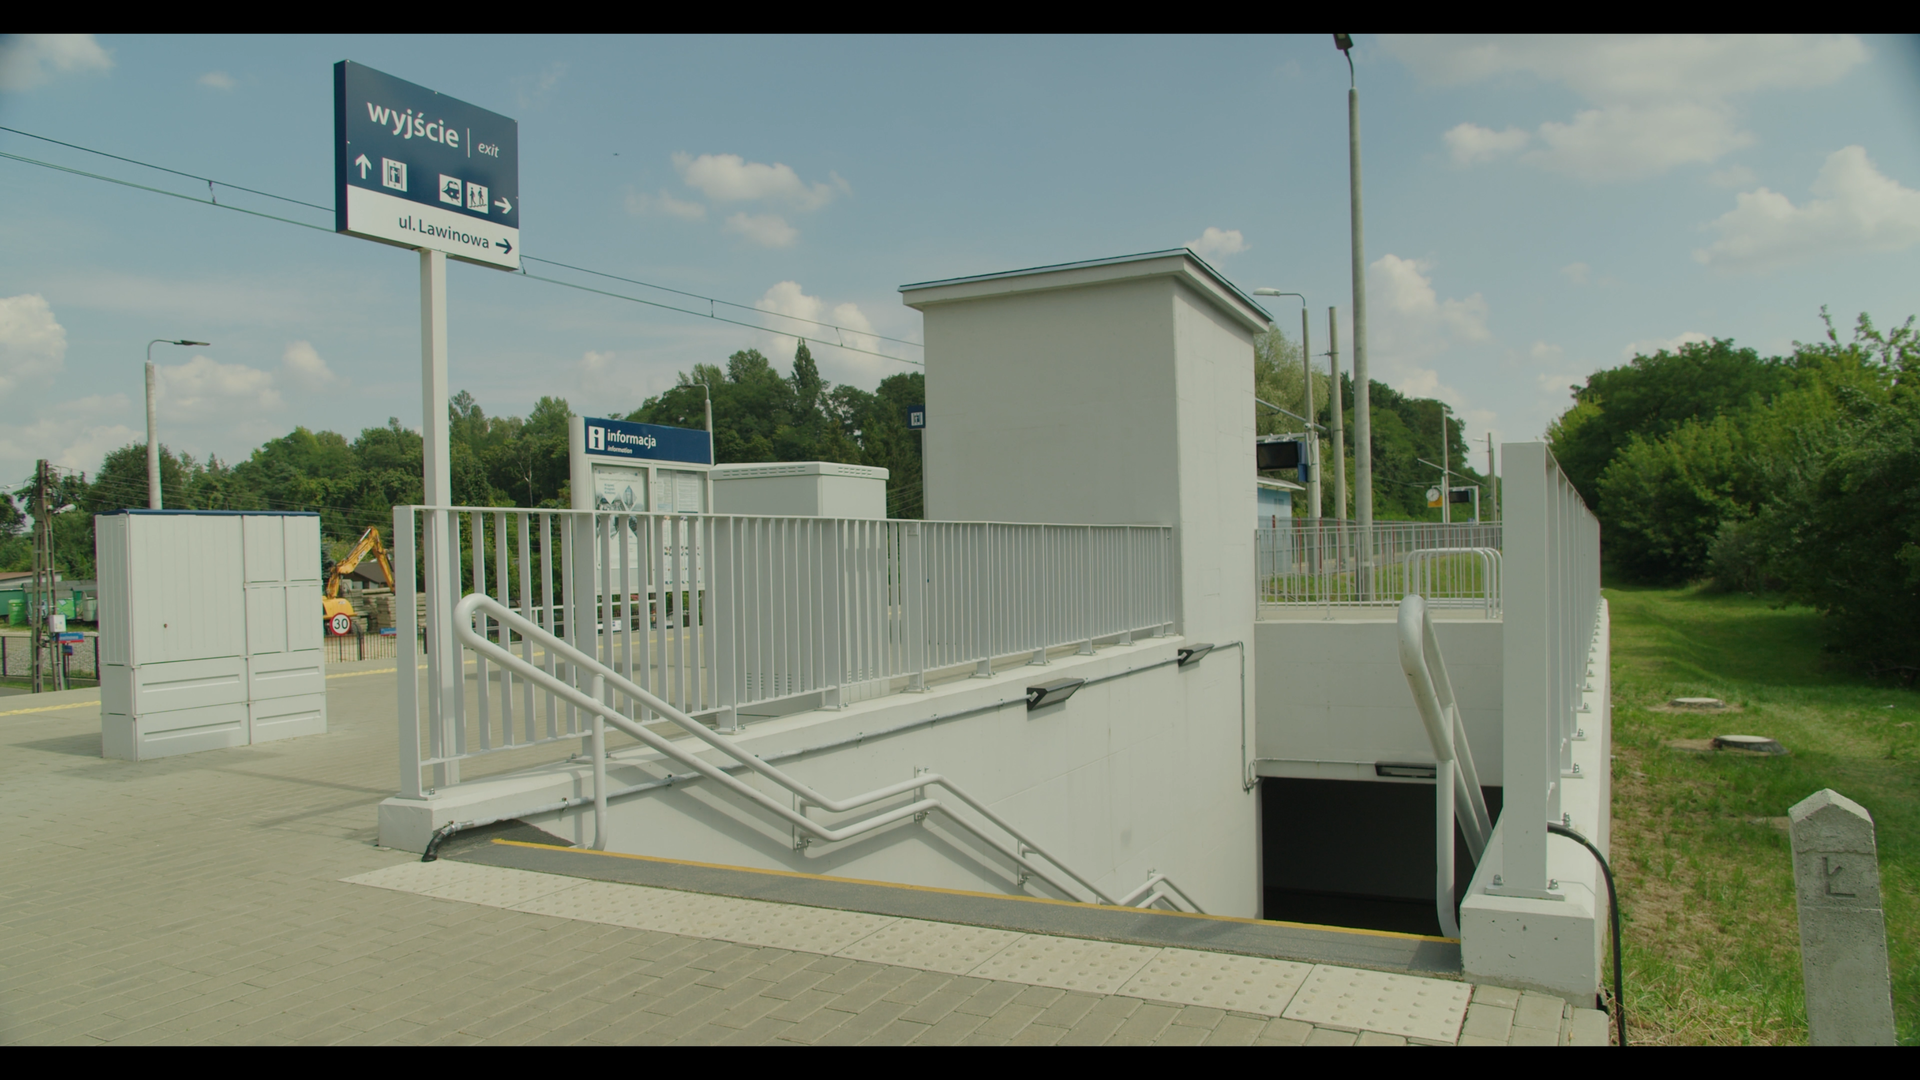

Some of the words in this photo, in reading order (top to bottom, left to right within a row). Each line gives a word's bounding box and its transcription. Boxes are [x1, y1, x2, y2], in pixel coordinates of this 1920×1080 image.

[367, 102, 460, 148] wyjście
[478, 142, 500, 158] exit
[399, 215, 416, 231] ul.
[419, 219, 490, 248] Lawinowa
[607, 429, 656, 449] informacja
[607, 445, 633, 454] information
[334, 618, 348, 630] 30
